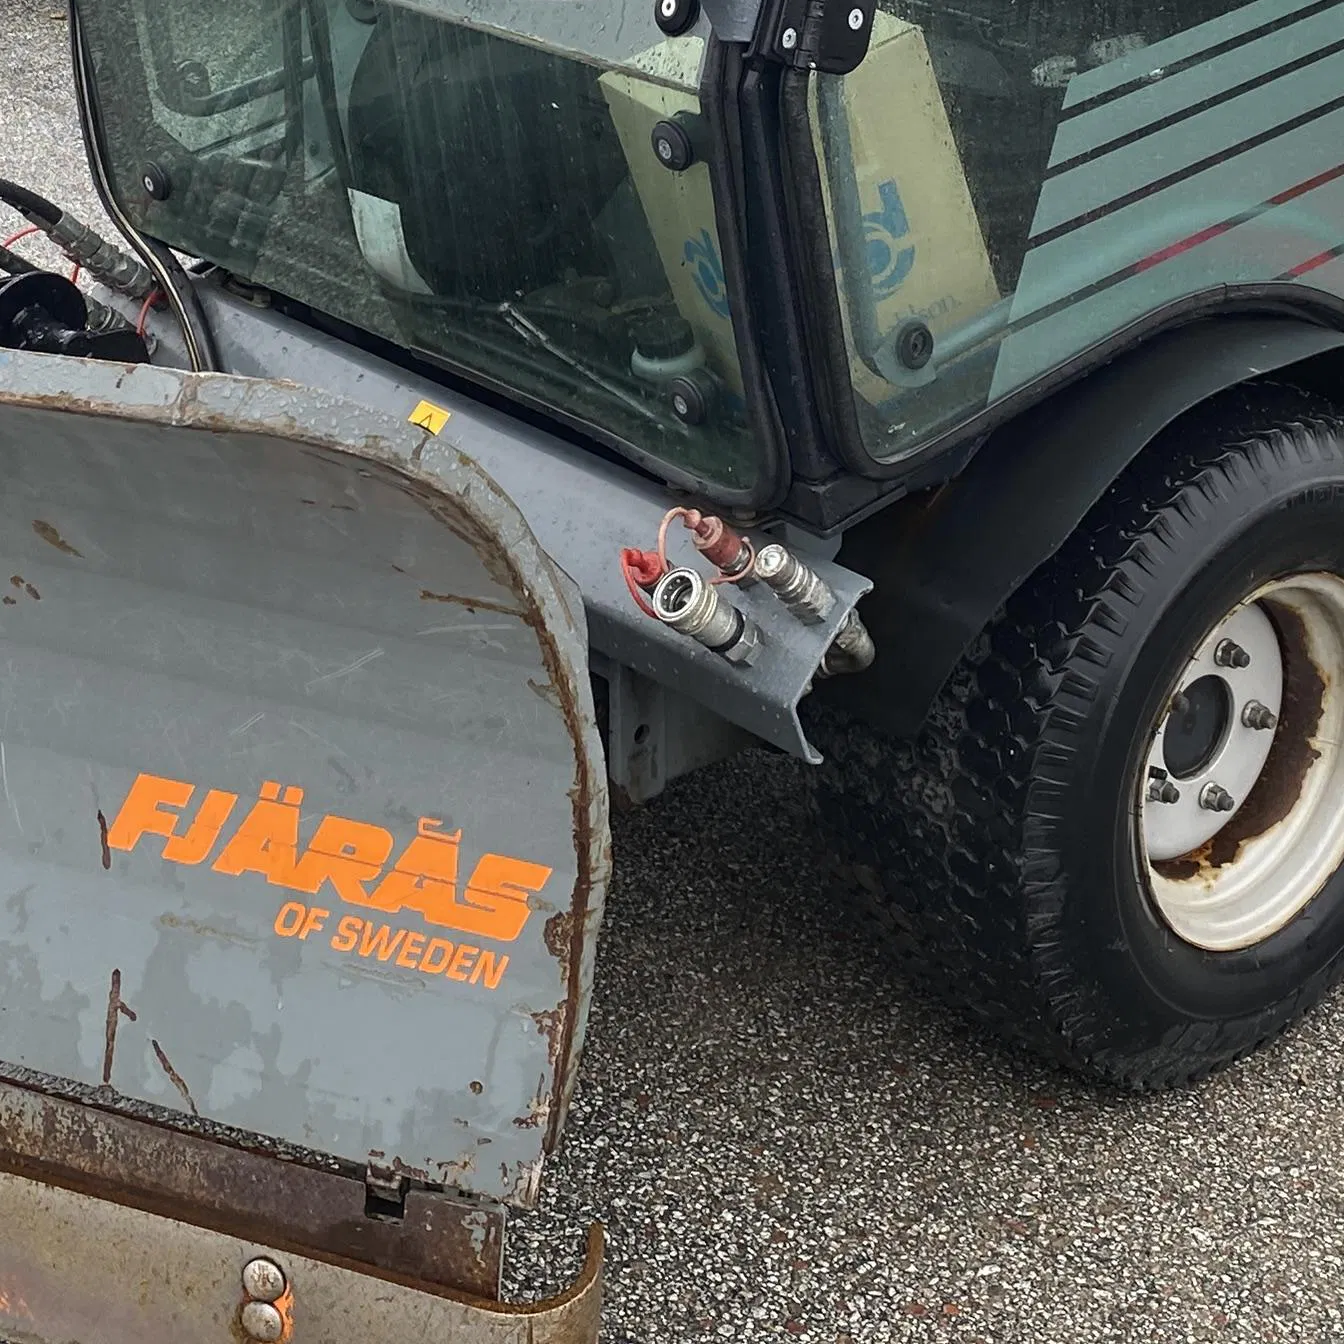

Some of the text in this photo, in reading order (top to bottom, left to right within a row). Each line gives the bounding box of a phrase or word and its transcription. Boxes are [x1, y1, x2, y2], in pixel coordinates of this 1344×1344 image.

[107, 772, 553, 942] FJÄRÅS
[273, 901, 510, 990] OF SWEDEN
